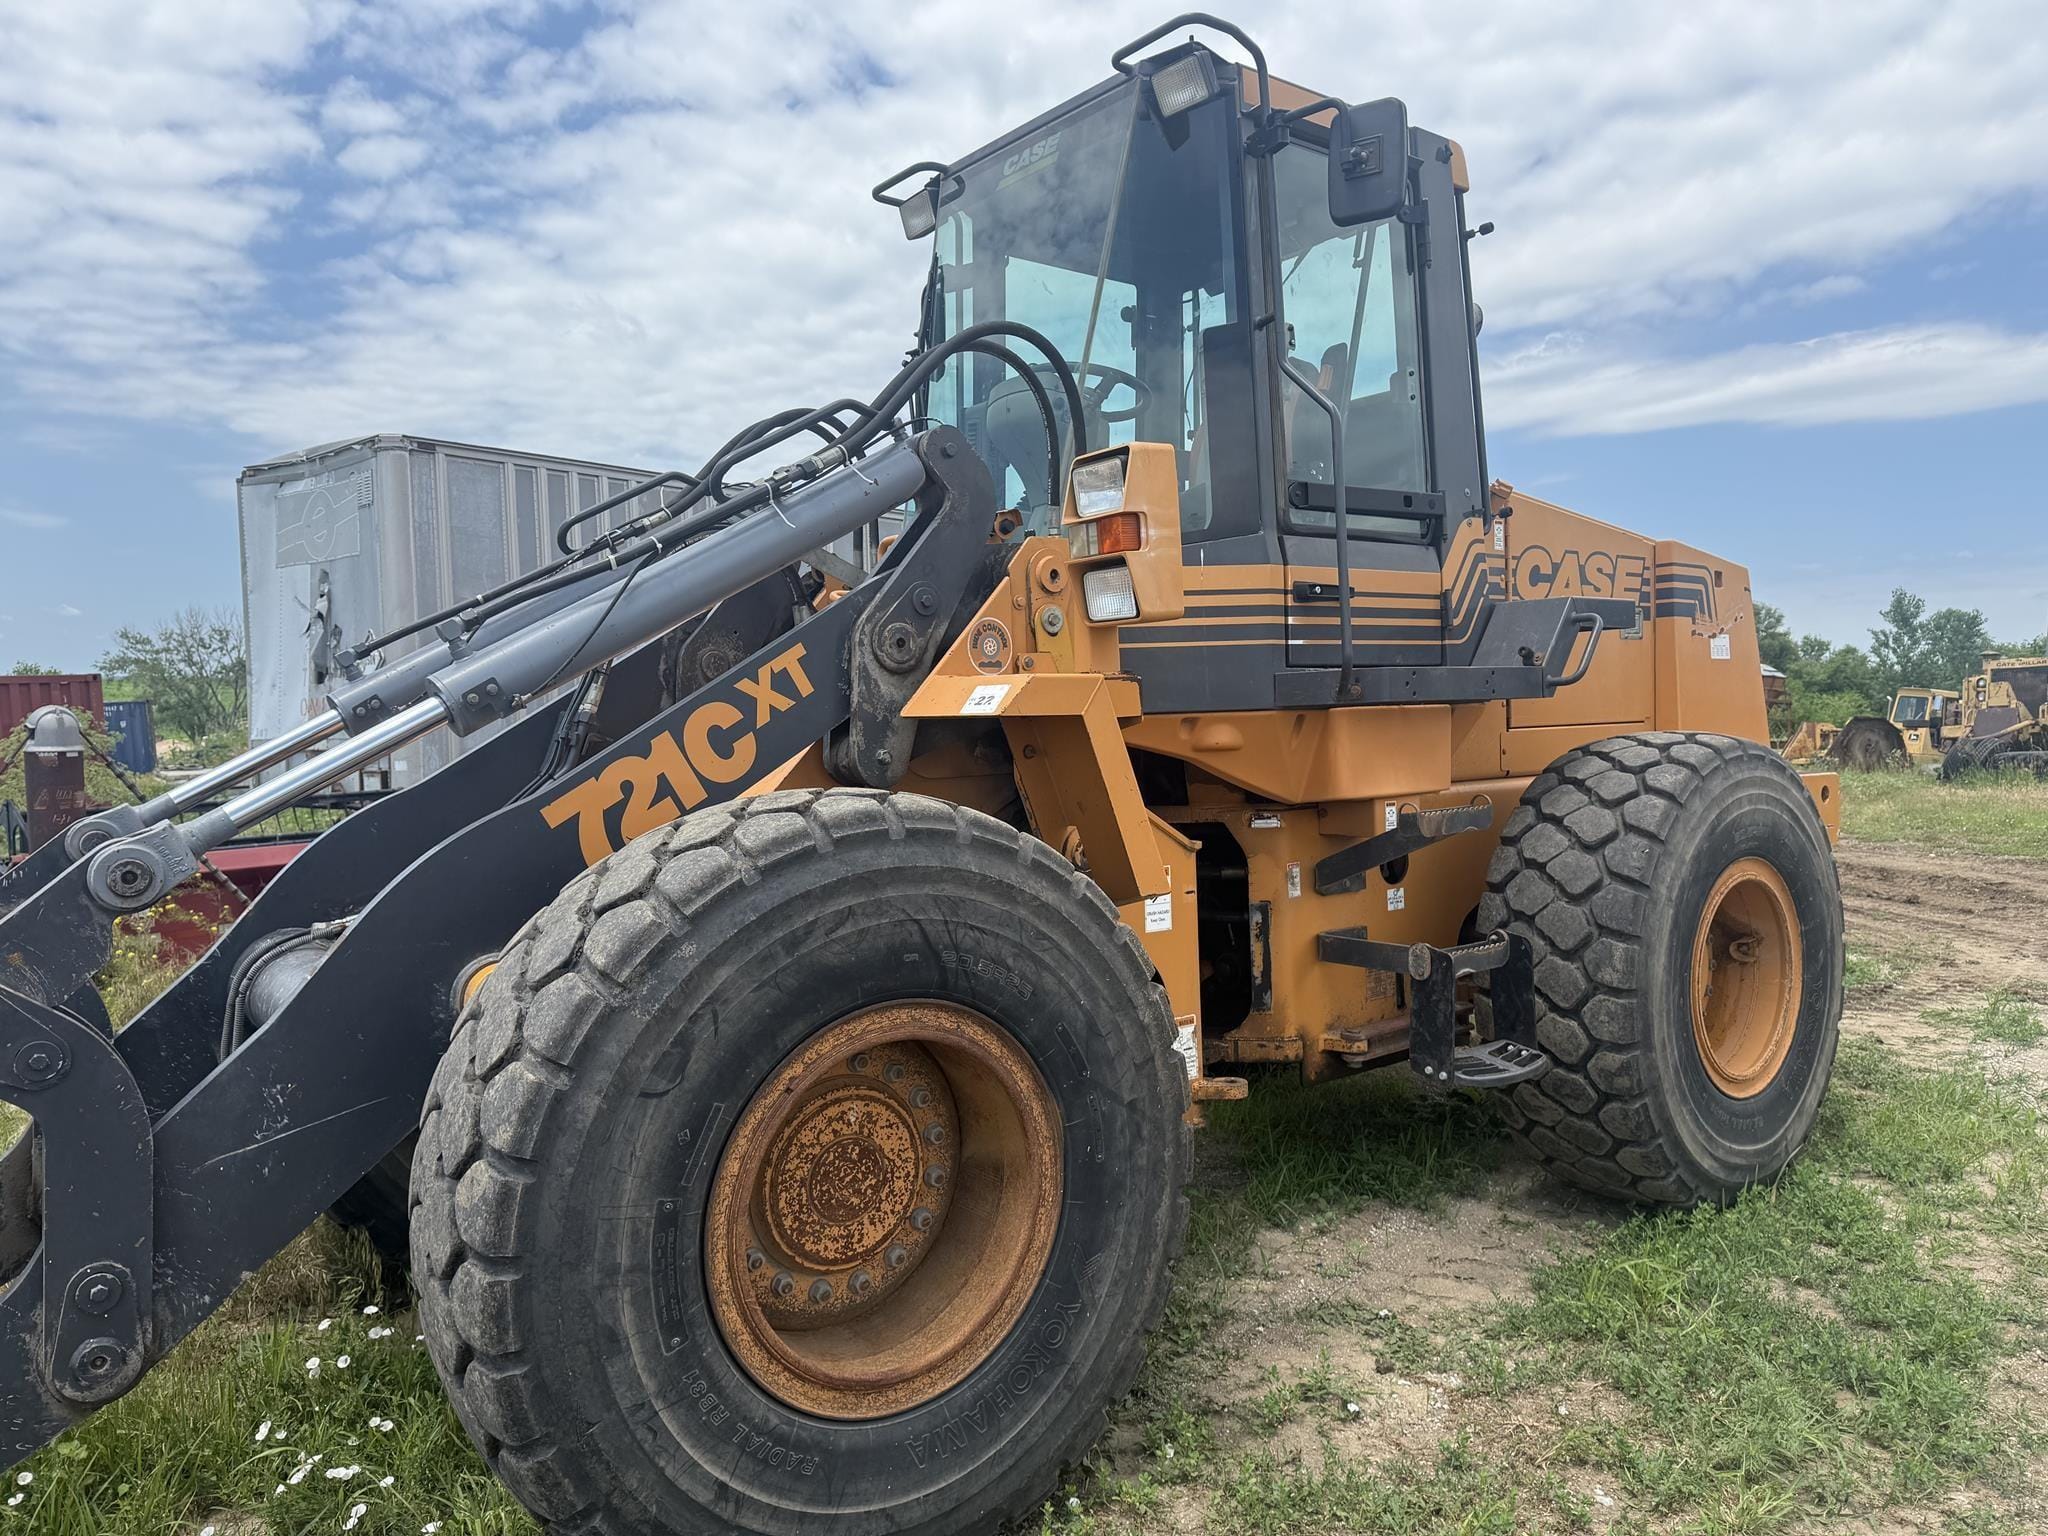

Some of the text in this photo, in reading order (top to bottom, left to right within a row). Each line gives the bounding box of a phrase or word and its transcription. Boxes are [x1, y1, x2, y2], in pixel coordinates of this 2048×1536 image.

[1003, 132, 1062, 176] CASE
[1515, 545, 1646, 606] CASE
[681, 1369, 818, 1475] RADIAL RB31
[904, 1299, 1083, 1469] YOKOHAMA
